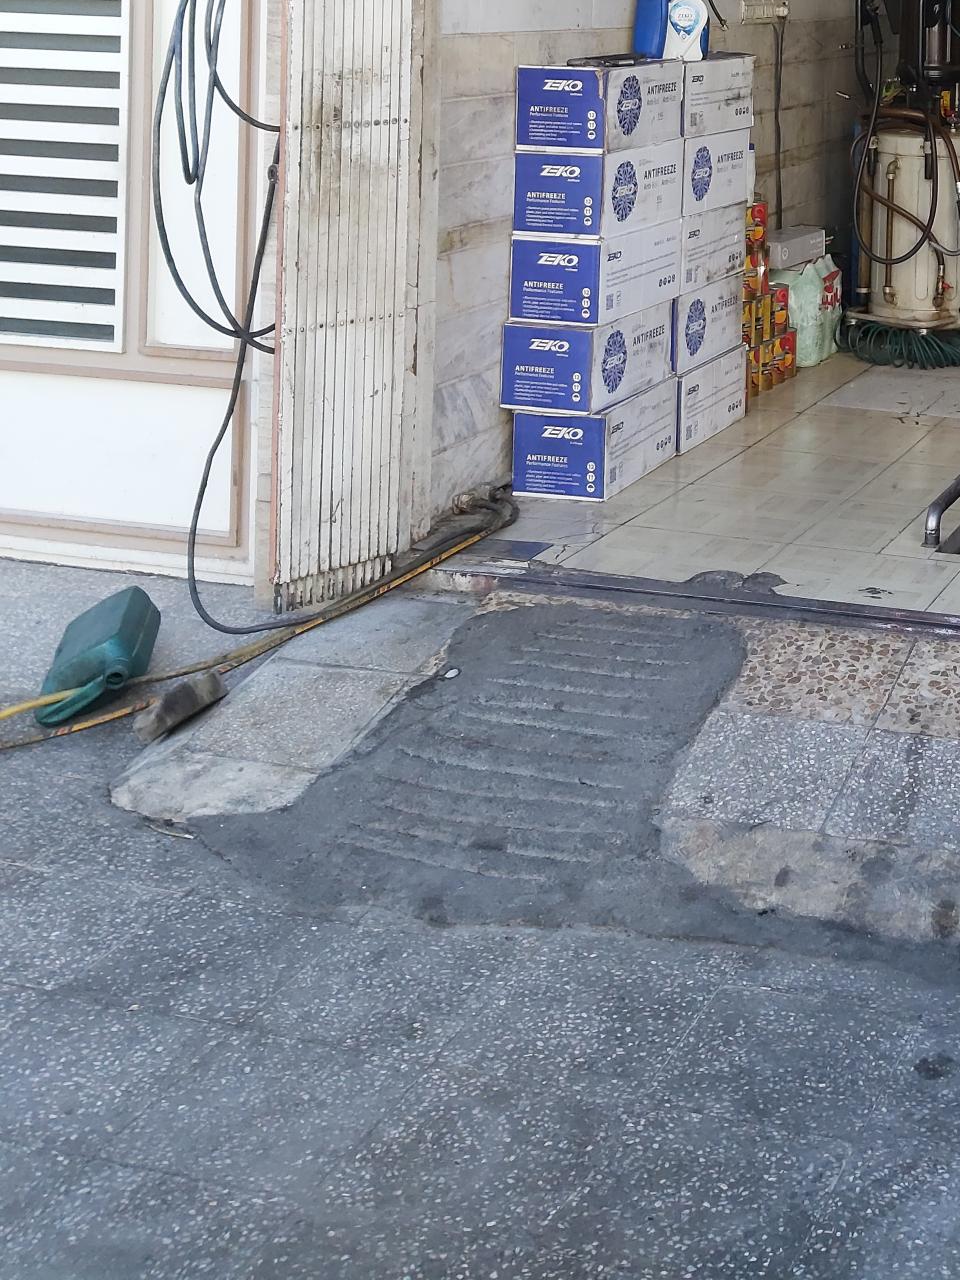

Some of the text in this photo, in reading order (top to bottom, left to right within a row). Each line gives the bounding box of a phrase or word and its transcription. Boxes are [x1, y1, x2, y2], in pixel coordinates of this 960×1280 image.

[542, 80, 582, 91] ZEKO
[647, 82, 677, 96] ANTIFREEZE
[717, 151, 744, 163] ANTIFREEZE
[540, 165, 580, 177] ZEKO
[644, 164, 677, 180] ANTIFREEZE
[537, 253, 578, 266] ZEKO
[523, 281, 564, 289] ANTIFREEZE
[632, 324, 665, 346] ANTIFREEZE
[528, 339, 570, 352] ZEKO
[515, 365, 555, 374] ANTIFREEZE
[541, 426, 583, 439] ZEKO
[527, 454, 568, 463] ANTIFREEZE
